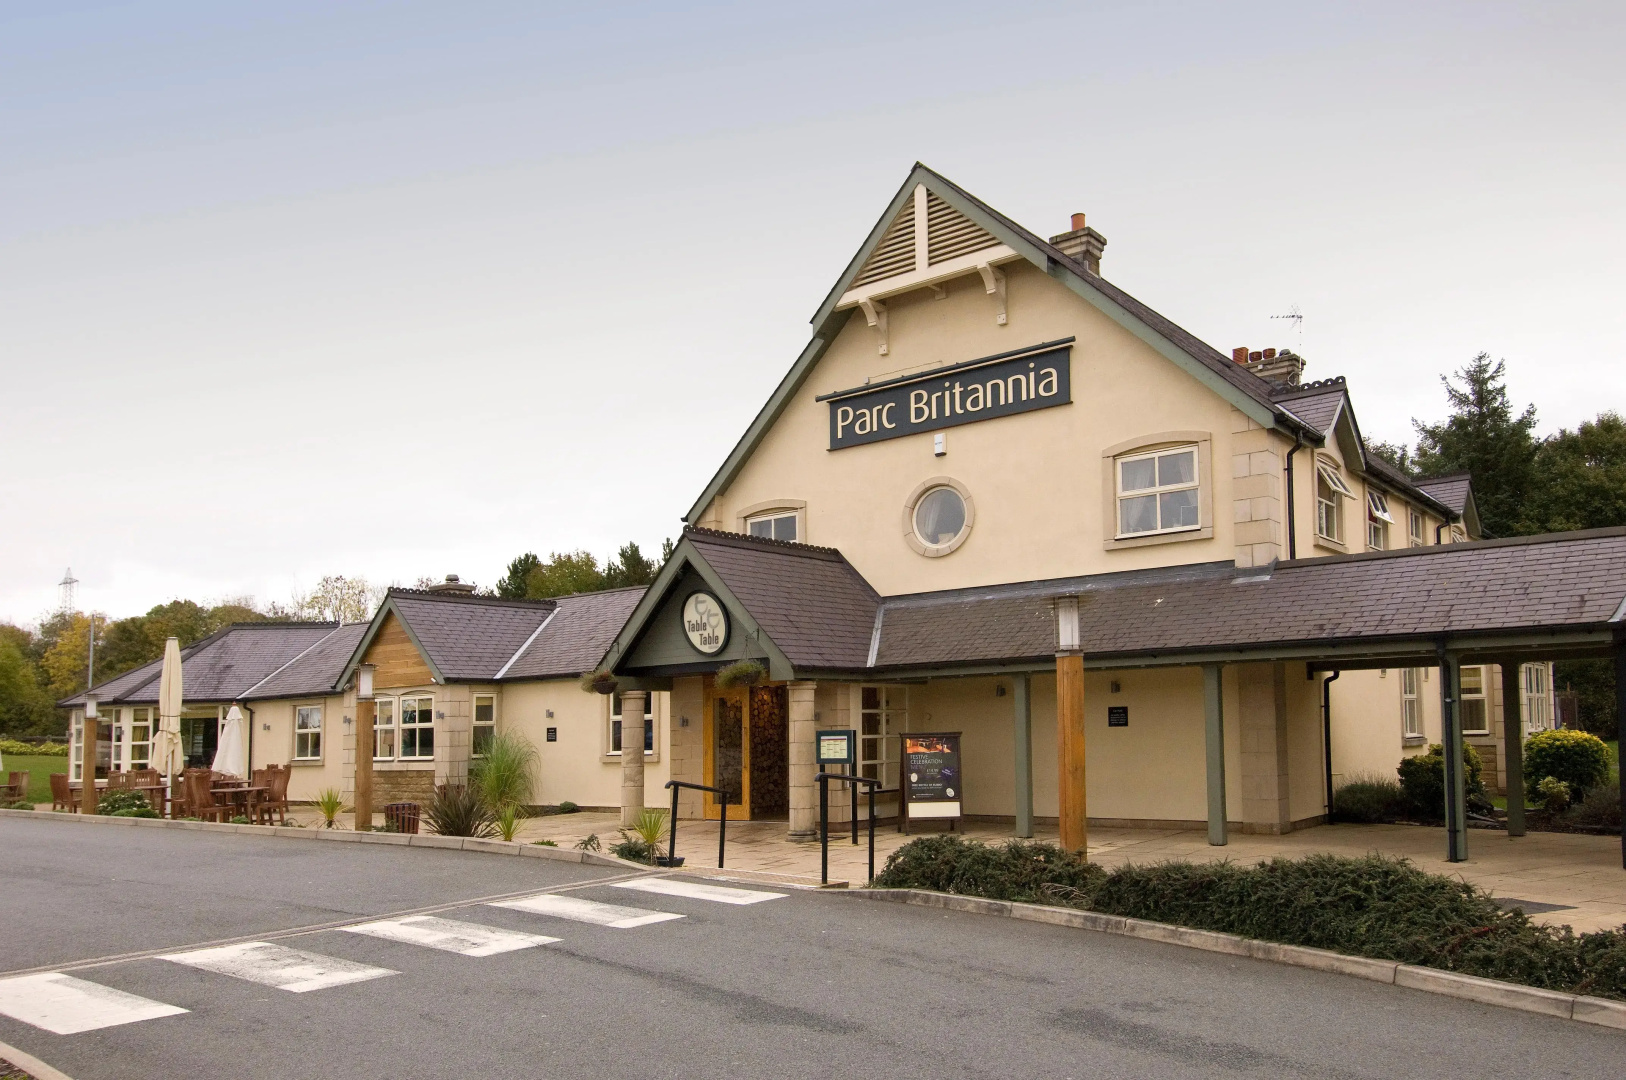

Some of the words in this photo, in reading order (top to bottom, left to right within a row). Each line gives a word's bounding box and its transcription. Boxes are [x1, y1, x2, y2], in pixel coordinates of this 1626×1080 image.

[837, 402, 896, 439] Parc
[909, 362, 1058, 424] Britannia
[687, 619, 707, 632] Table
[699, 632, 719, 645] Table
